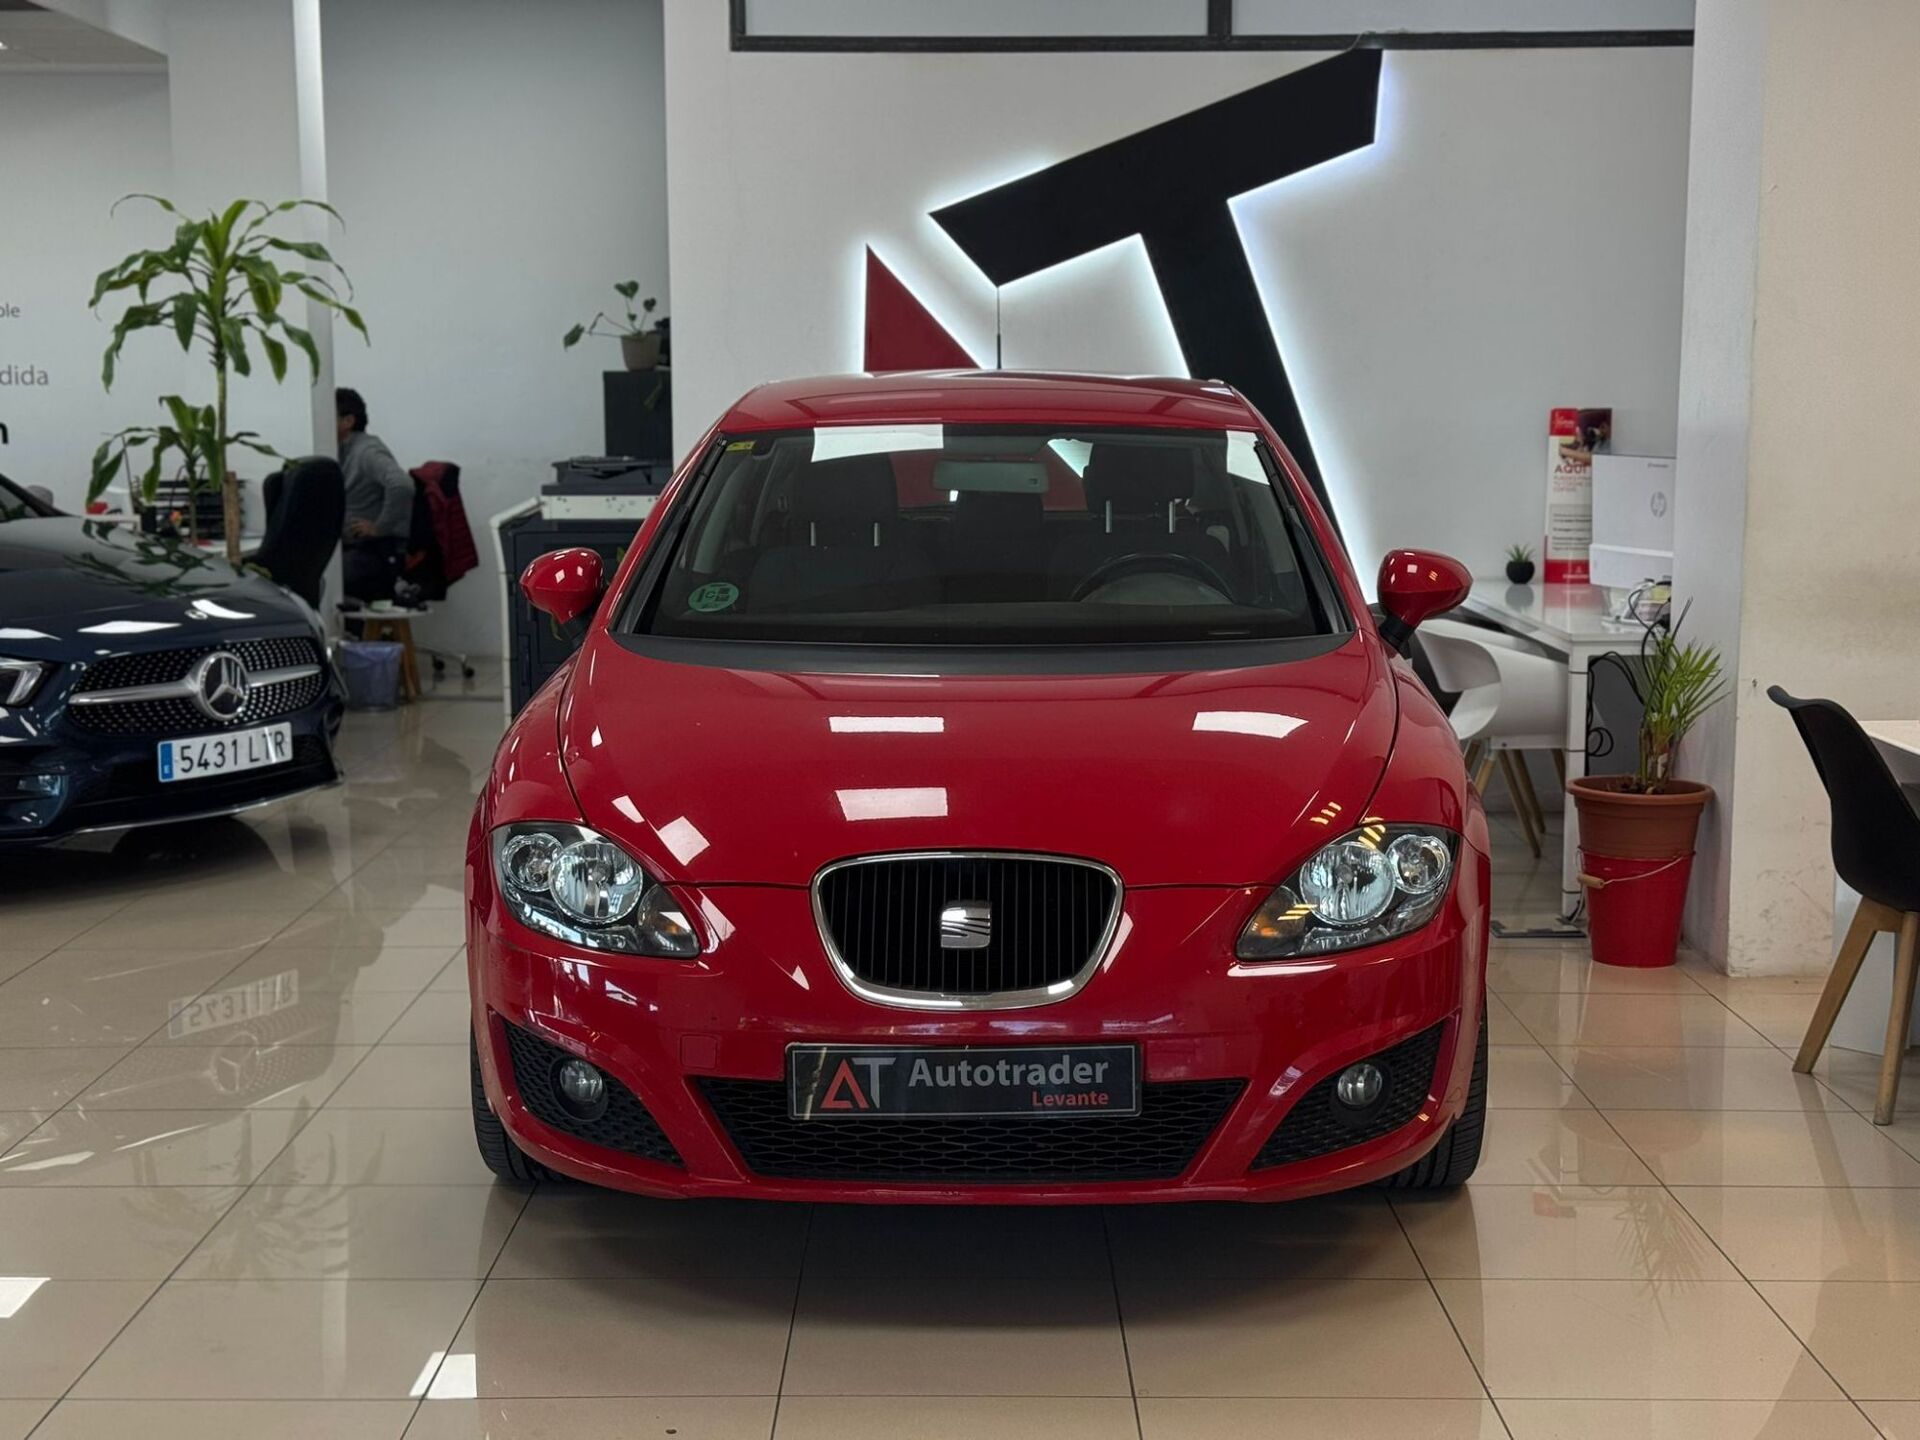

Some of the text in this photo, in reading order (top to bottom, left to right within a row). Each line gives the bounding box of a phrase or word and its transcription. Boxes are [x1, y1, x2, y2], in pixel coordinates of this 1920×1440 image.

[180, 739, 238, 774] 5431
[908, 1054, 1109, 1088] Autotrader
[1031, 1090, 1109, 1107] Levante
